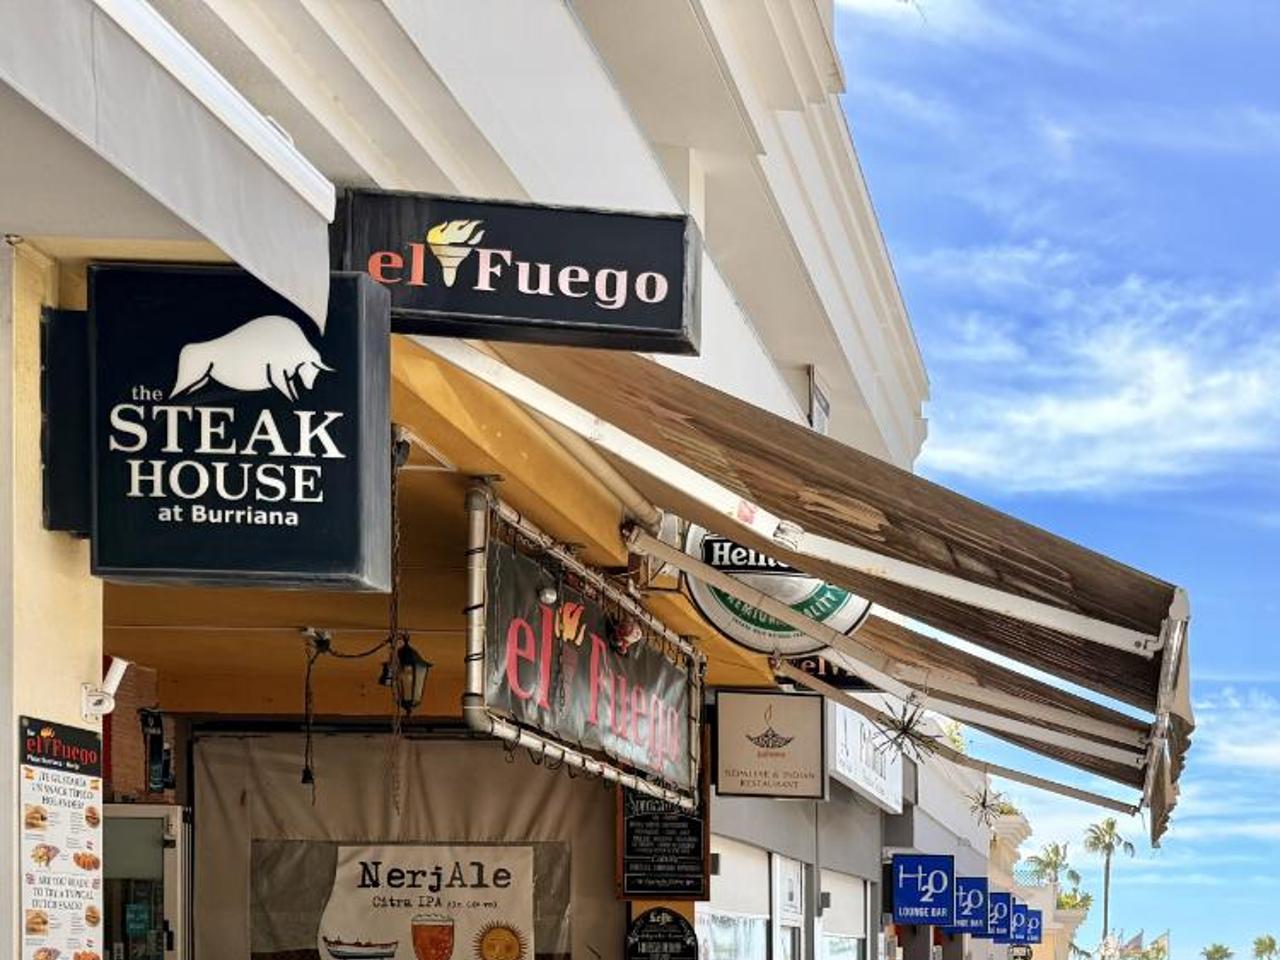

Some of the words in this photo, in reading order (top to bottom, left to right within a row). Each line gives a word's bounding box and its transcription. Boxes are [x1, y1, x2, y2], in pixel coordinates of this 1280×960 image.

[367, 243, 426, 287] el
[473, 247, 670, 310] Fuego
[132, 386, 163, 401] the
[108, 404, 347, 459] STEAK
[125, 460, 324, 504] HOUSE
[157, 504, 183, 523] at
[191, 504, 299, 527] Burriana
[506, 602, 554, 711] el
[587, 633, 681, 773] Fuego
[53, 738, 97, 766] Fuego
[740, 779, 799, 789] RESTAURANT
[357, 861, 511, 893] NerjAle
[418, 896, 442, 908] IPA
[899, 907, 929, 917] LOUNGE
[931, 907, 948, 918] BAR
